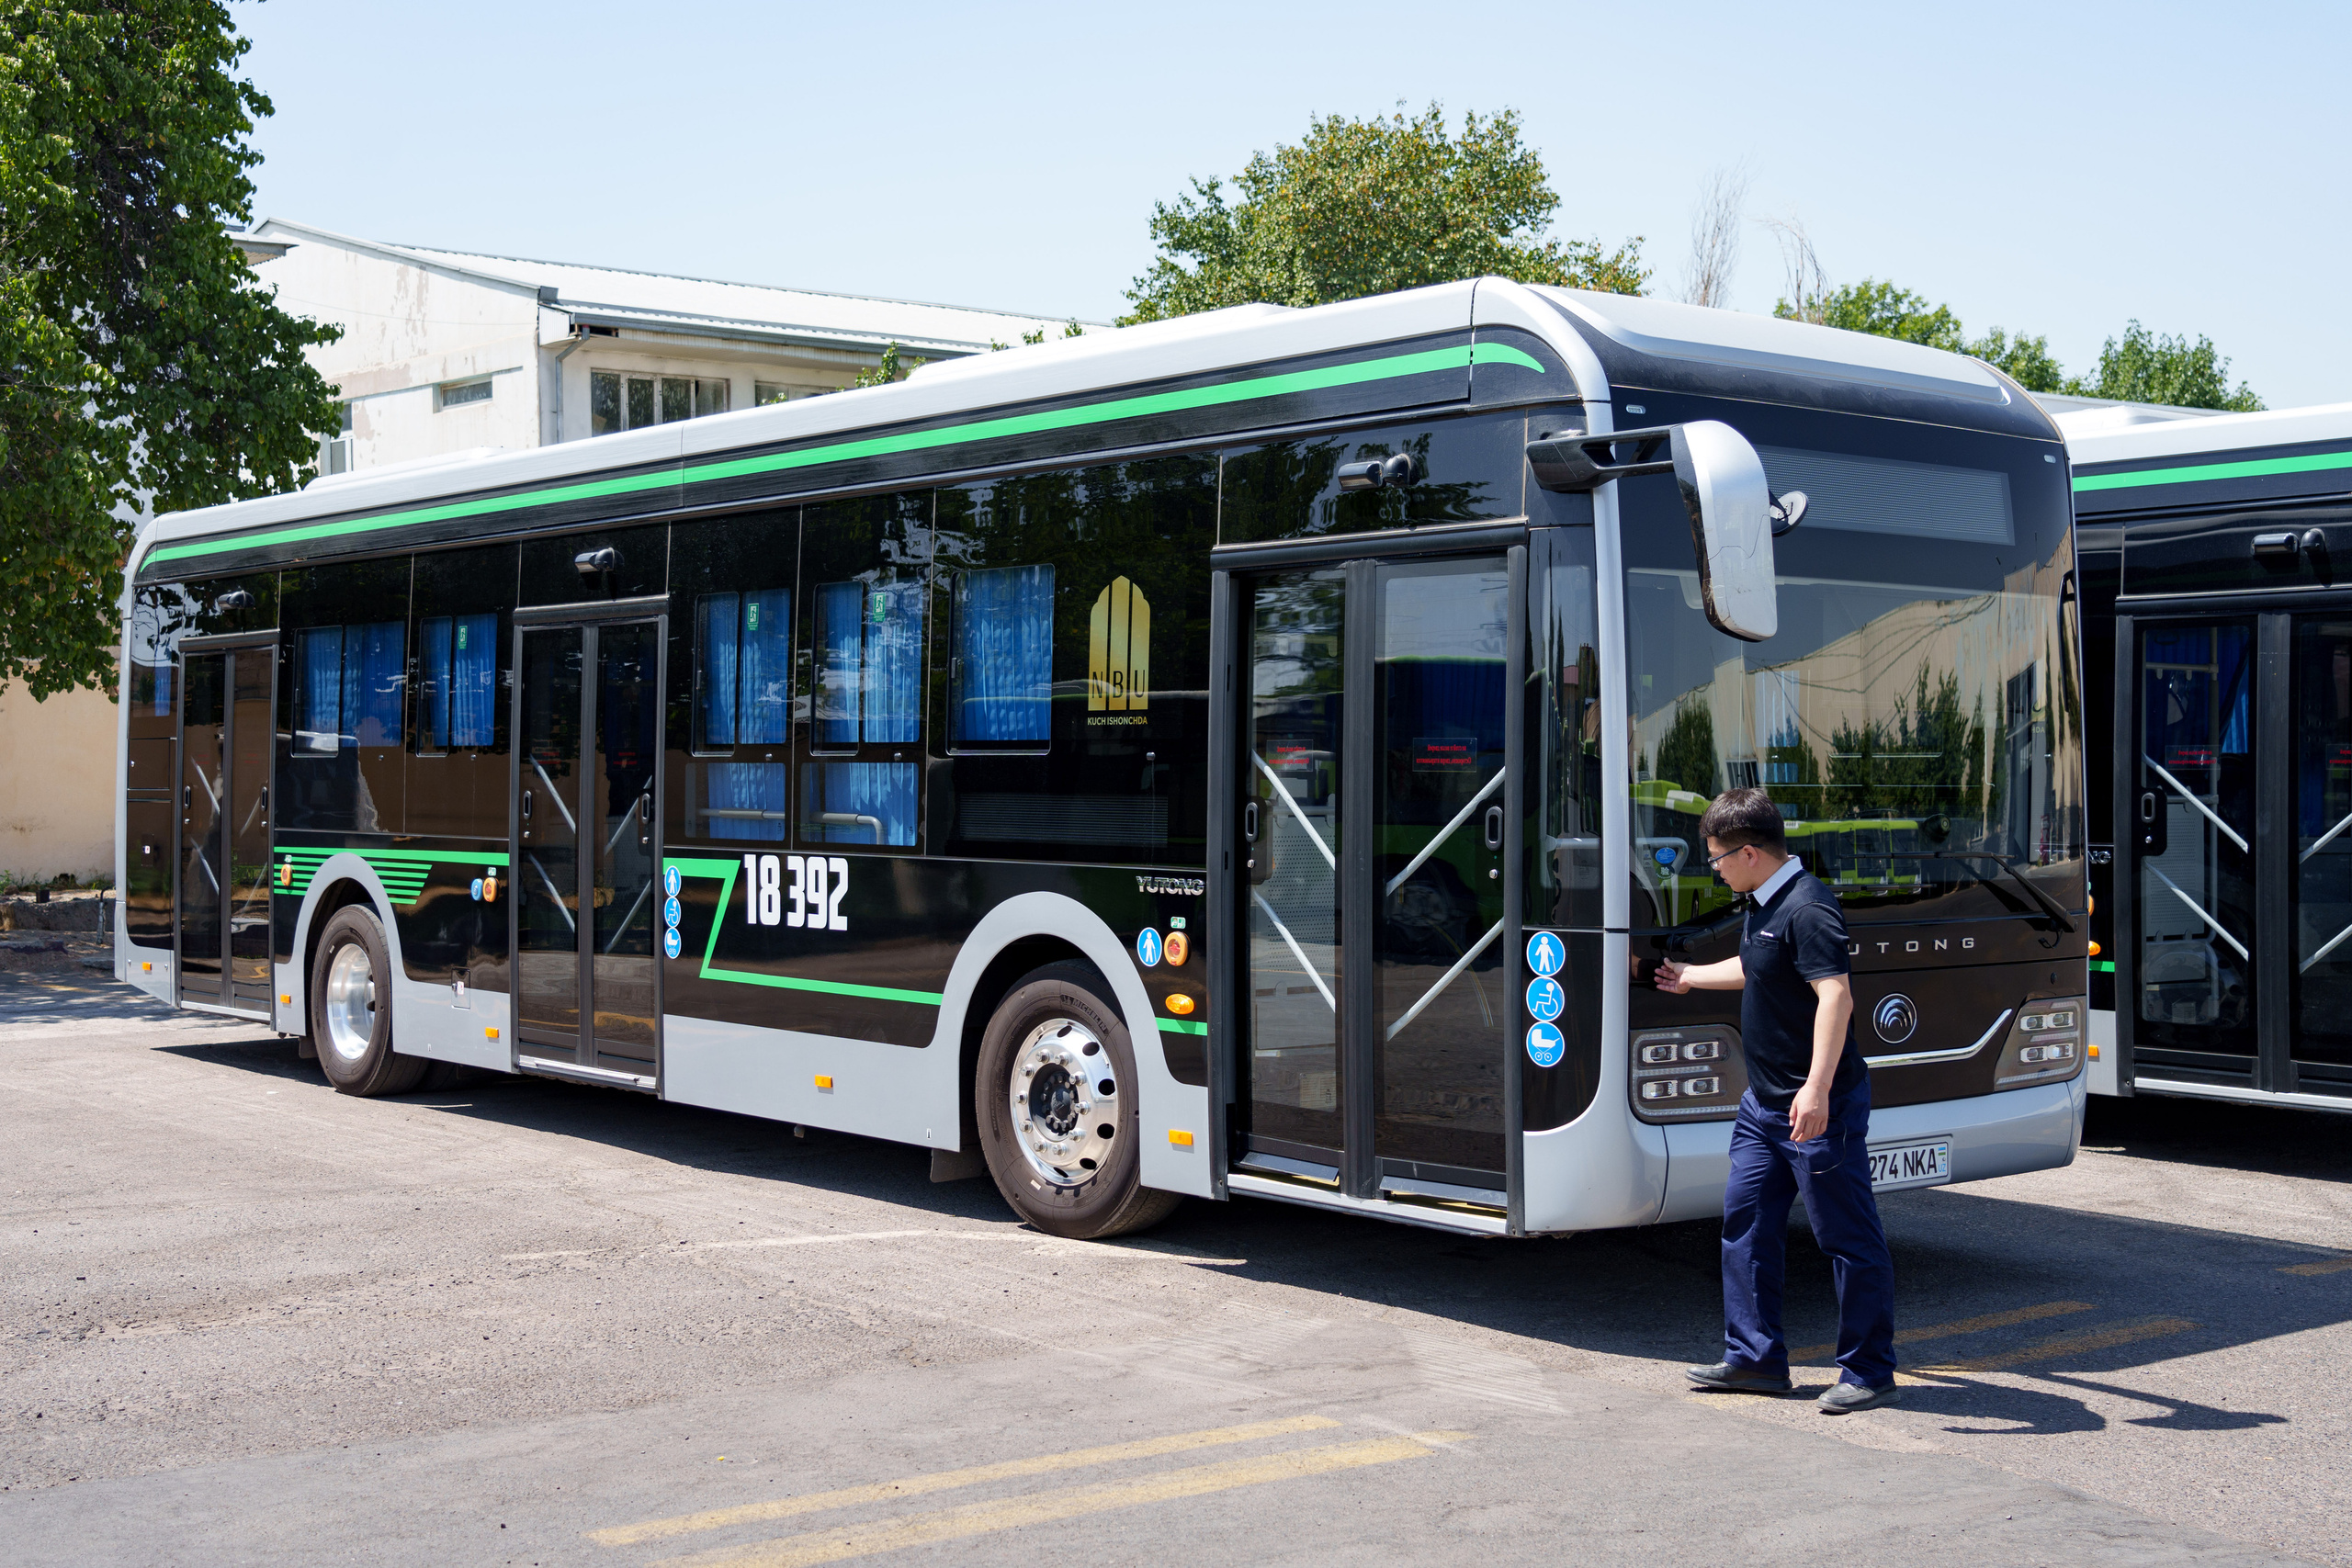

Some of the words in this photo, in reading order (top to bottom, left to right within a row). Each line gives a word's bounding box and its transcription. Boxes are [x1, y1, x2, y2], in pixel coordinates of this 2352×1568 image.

[1091, 670, 1145, 698] NBU
[1087, 716, 1106, 726] KUCH
[1106, 716, 1148, 725] ISHONCHDA
[744, 853, 781, 926] 18
[786, 855, 849, 931] 392
[1136, 875, 1205, 896] YUTONG
[1848, 937, 1974, 955] UTONG
[1869, 1153, 1899, 1182] 274
[1904, 1148, 1938, 1178] NKA
[1938, 1163, 1947, 1172] UZ
